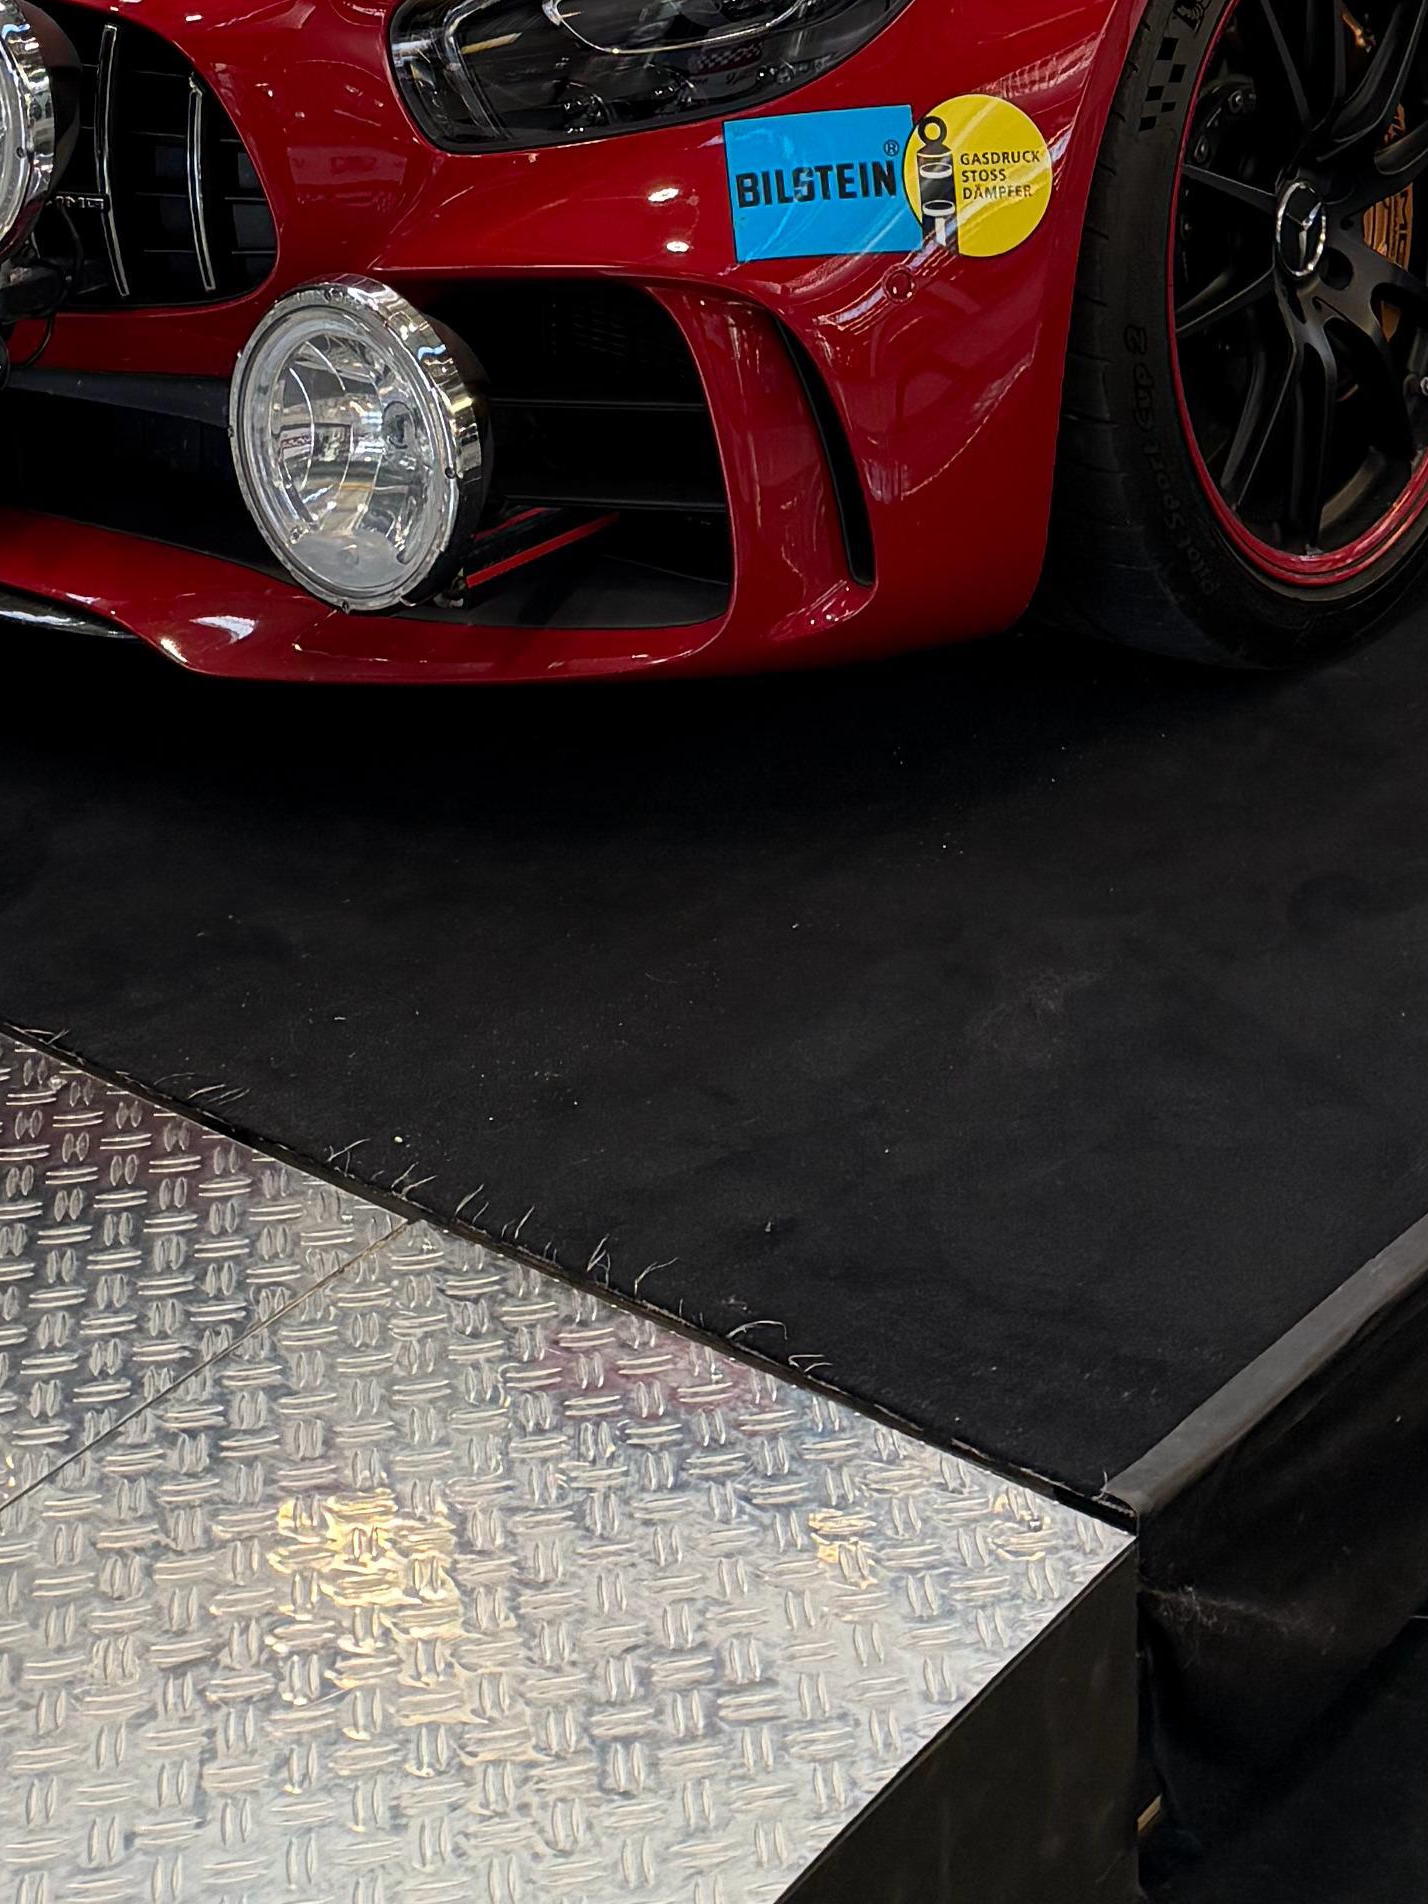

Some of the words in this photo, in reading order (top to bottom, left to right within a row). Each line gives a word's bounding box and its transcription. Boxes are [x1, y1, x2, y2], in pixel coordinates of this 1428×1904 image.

[959, 148, 1042, 168] GASDRUCK
[735, 157, 897, 210] BILSTEIN
[960, 167, 1007, 185] STOSS
[962, 180, 1035, 201] DÄMPFER
